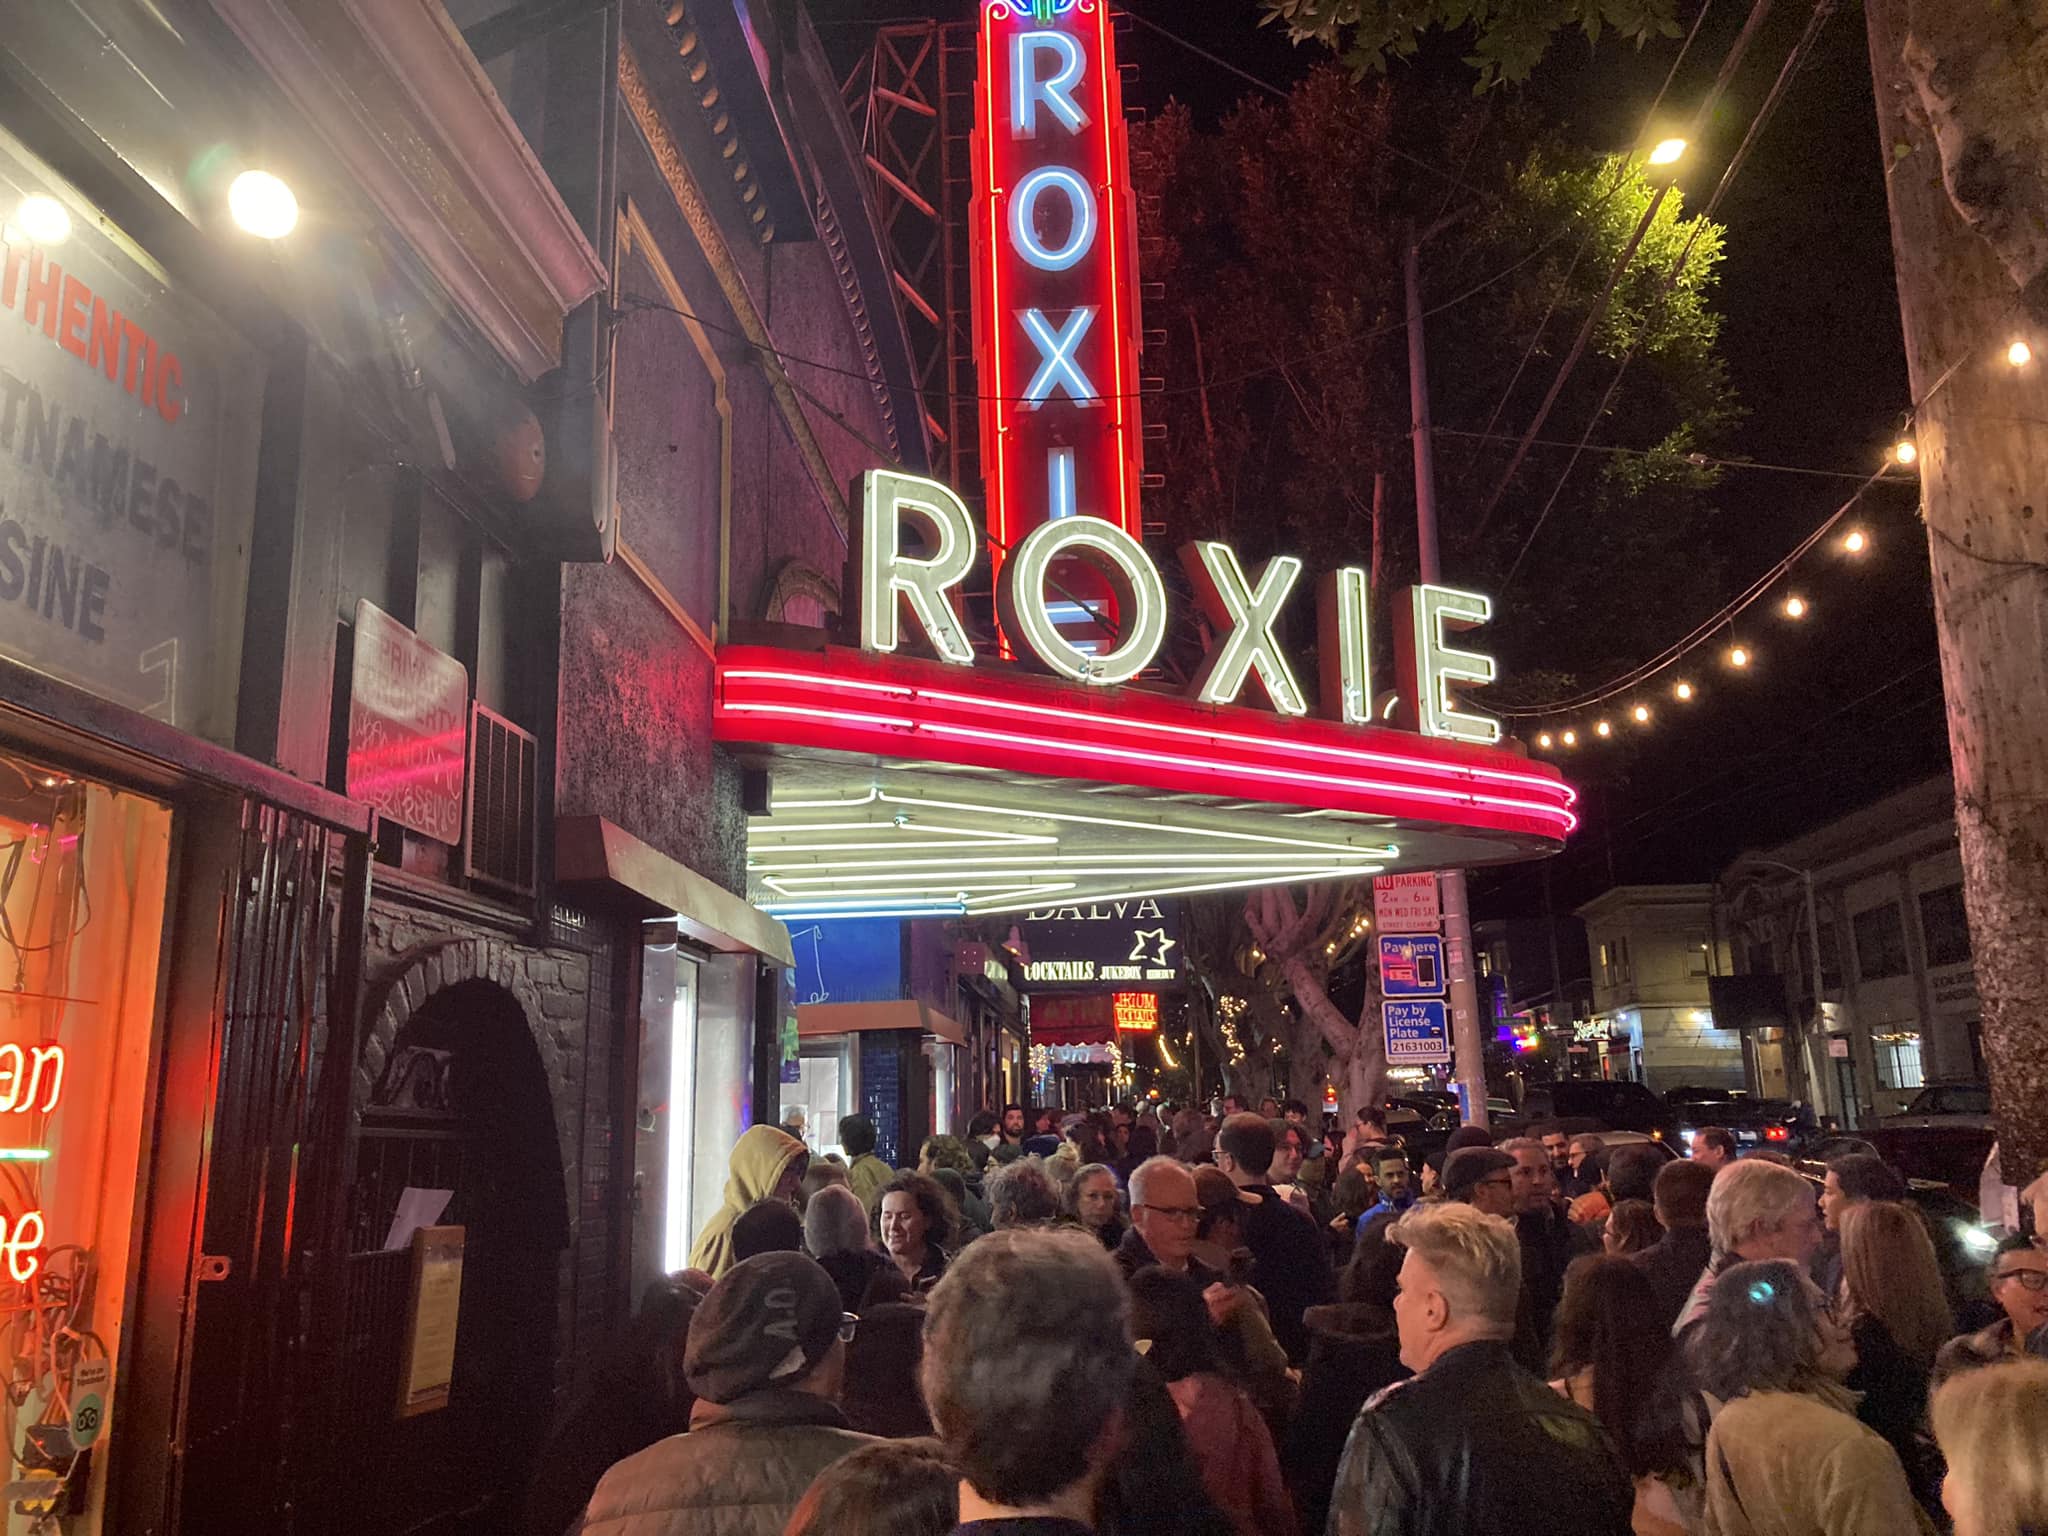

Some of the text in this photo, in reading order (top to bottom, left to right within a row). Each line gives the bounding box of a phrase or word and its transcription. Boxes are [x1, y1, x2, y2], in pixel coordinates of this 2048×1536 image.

[862, 469, 1500, 746] ROXIE
[1395, 874, 1433, 888] PARKING
[1381, 892, 1389, 903] 2
[1413, 891, 1421, 902] 6
[1025, 898, 1165, 920] ALVA
[1383, 940, 1437, 957] Pay here
[1387, 1003, 1426, 1018] Pay by
[1389, 1015, 1431, 1028] License
[1389, 1028, 1420, 1039] Plate
[1392, 1042, 1442, 1053] 21631003
